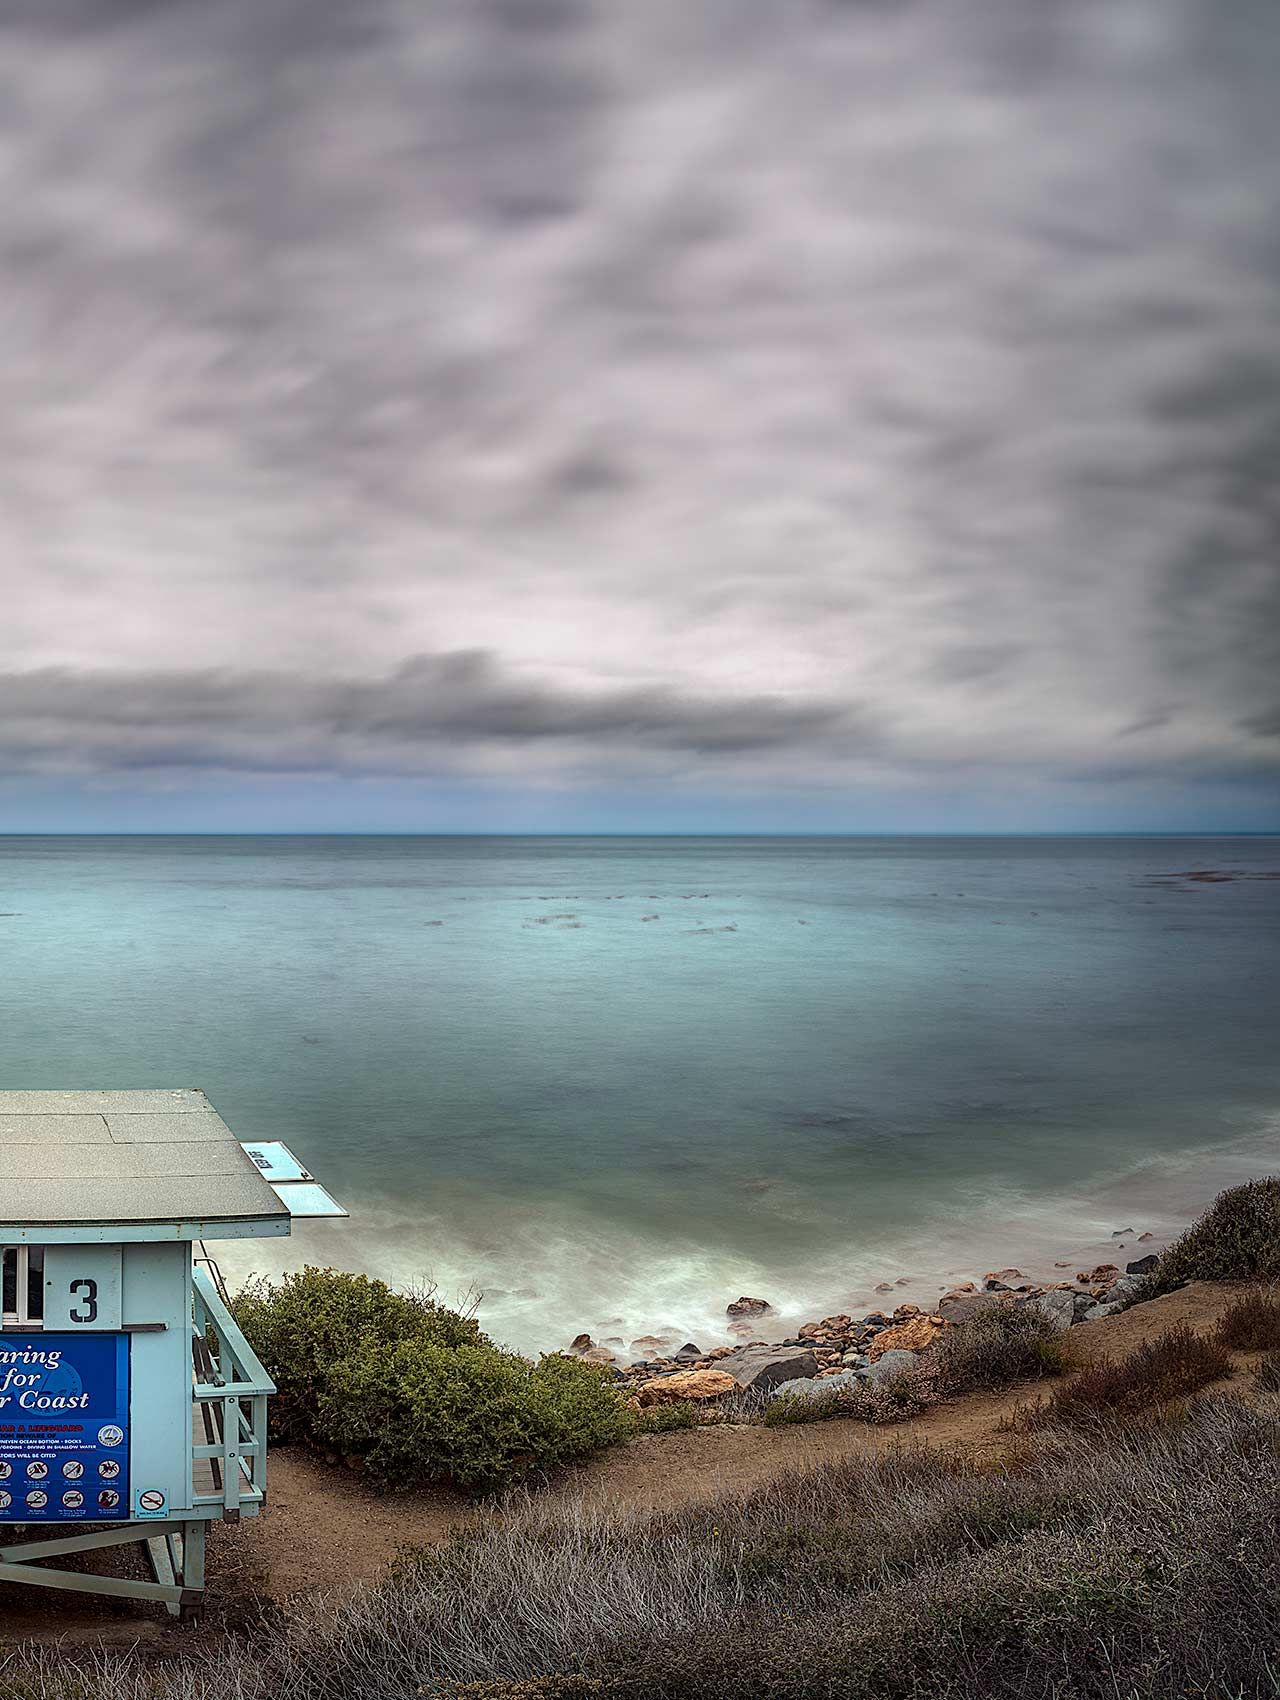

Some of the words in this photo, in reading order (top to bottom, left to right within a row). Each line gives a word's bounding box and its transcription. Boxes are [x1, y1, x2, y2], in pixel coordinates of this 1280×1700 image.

[70, 1279, 97, 1323] 3
[19, 1390, 89, 1409] Coast
[29, 1424, 84, 1432] LIFEGUARD
